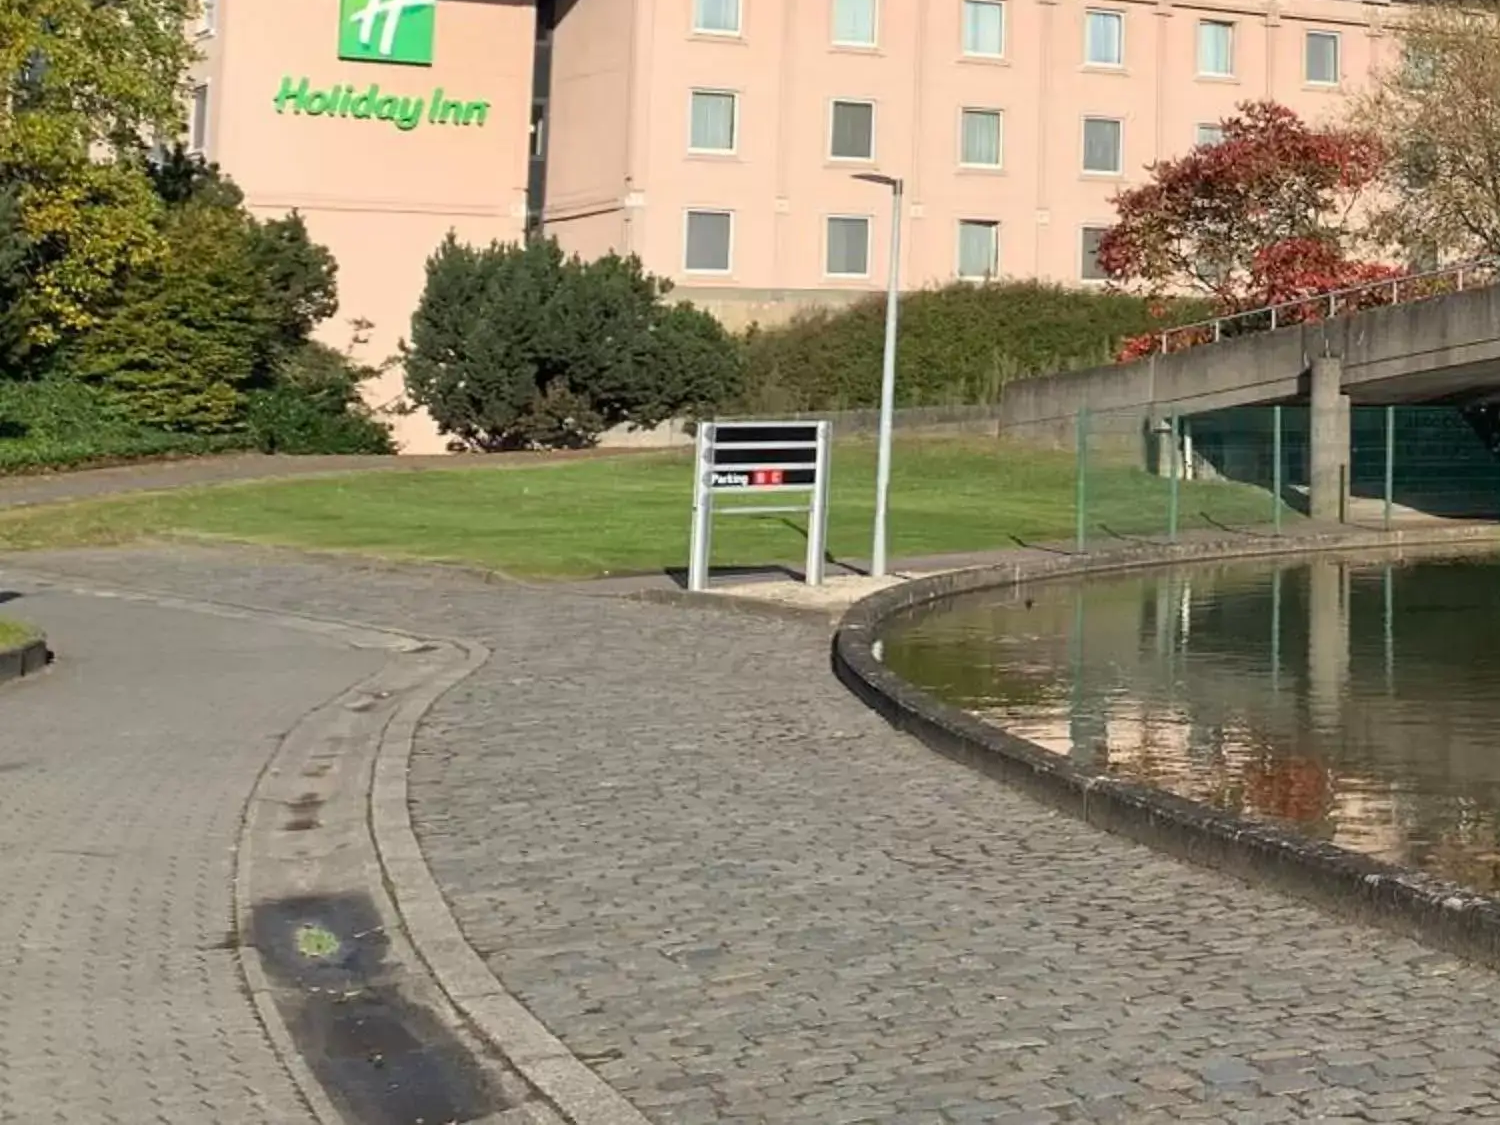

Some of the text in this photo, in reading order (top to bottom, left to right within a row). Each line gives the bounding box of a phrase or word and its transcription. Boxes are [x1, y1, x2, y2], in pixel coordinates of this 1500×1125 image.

[273, 77, 490, 131] Holiday Inn
[711, 472, 749, 487] Parking
